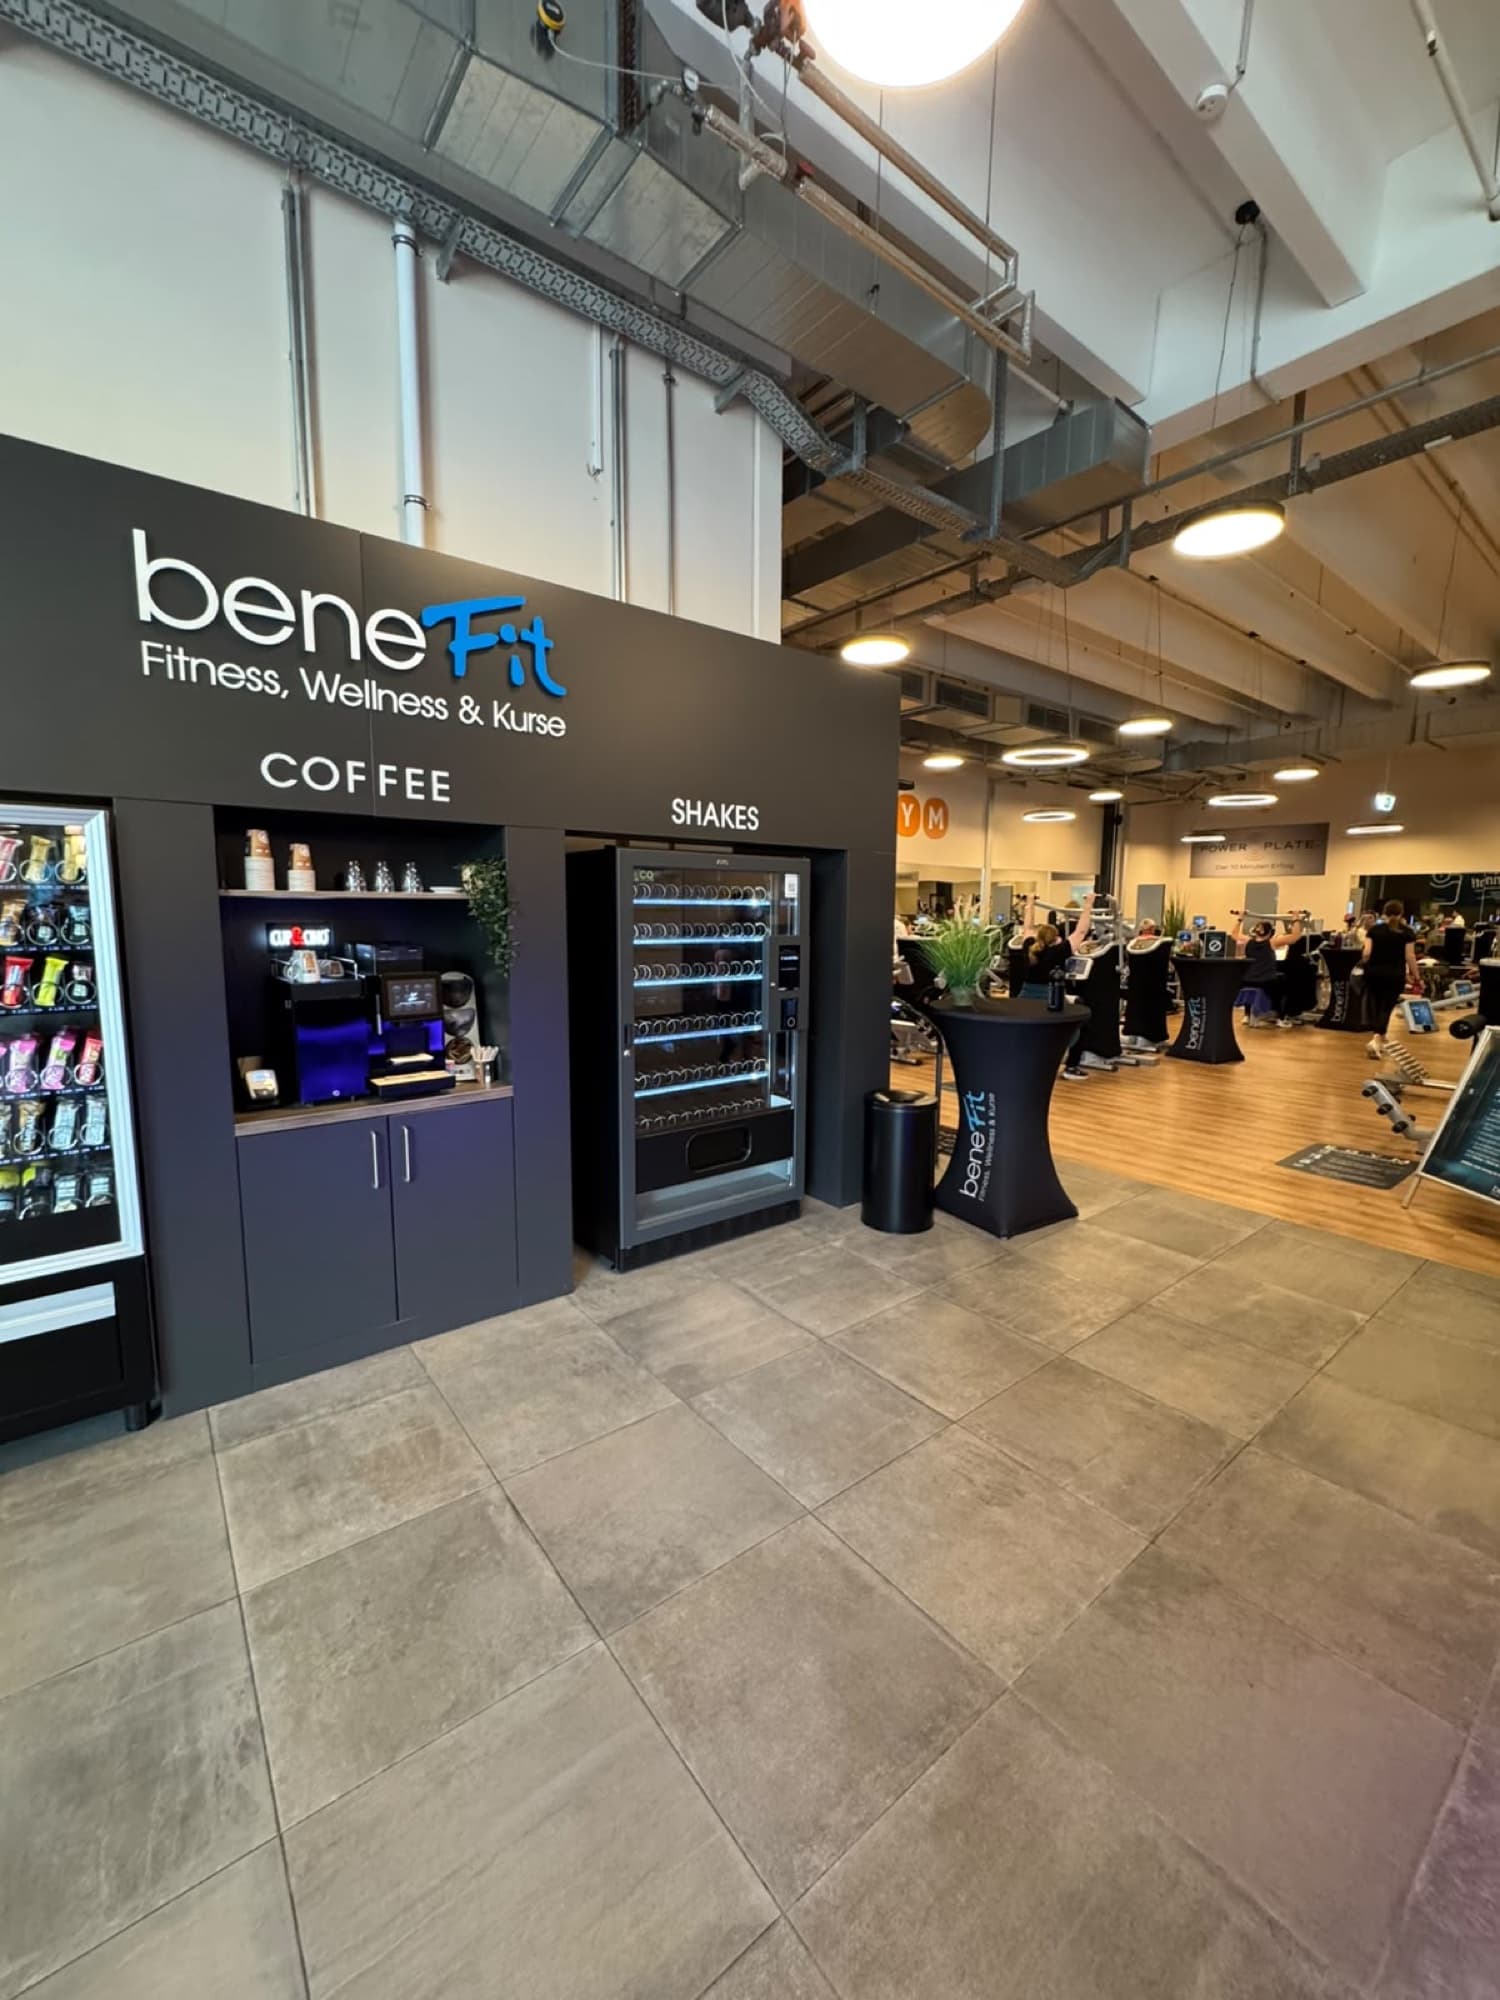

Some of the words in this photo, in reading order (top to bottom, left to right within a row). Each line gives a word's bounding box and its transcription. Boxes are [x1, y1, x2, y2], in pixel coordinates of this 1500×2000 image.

[132, 529, 567, 696] beneFit
[141, 640, 290, 700] Fitness,
[300, 669, 448, 721] Wellness
[459, 696, 484, 726] &
[493, 701, 567, 738] Kurse
[260, 752, 451, 803] COFFEE
[671, 798, 759, 830] SHAKES
[1199, 842, 1248, 853] POWER
[1263, 840, 1314, 852] PLATE
[959, 1090, 986, 1198] beneFit
